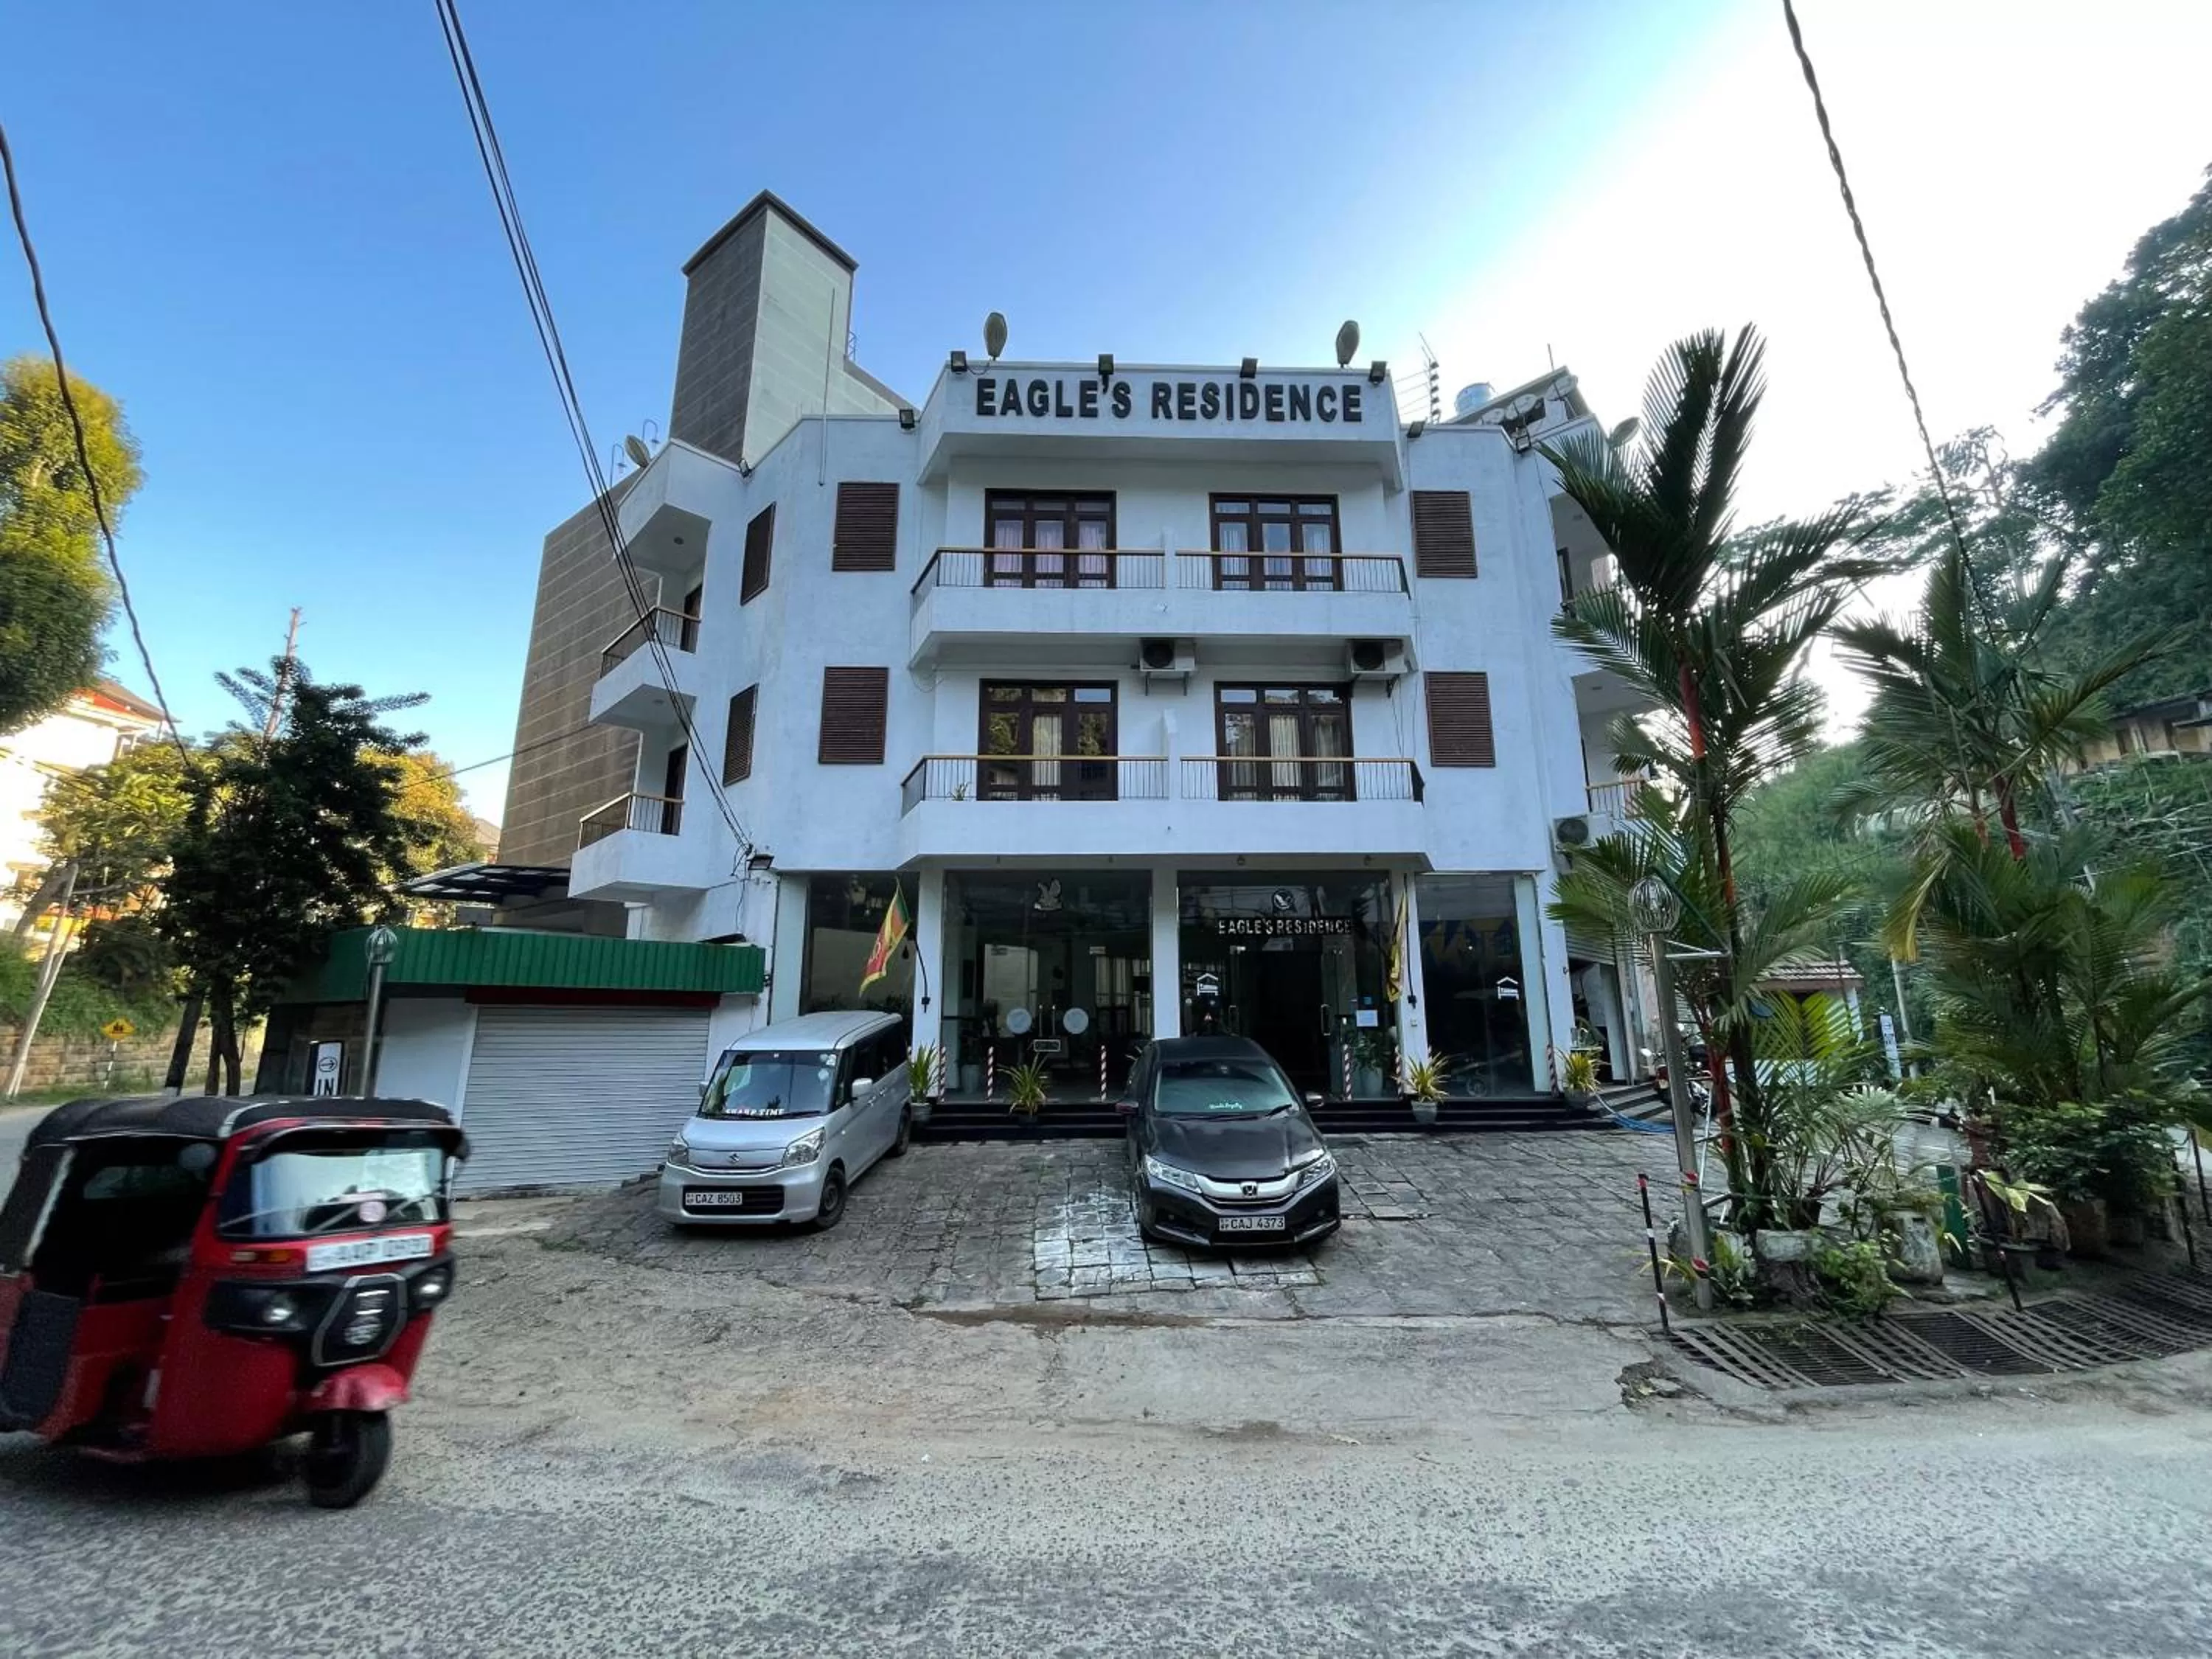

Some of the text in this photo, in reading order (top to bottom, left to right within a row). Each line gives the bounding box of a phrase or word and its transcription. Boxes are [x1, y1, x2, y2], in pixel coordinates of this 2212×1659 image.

[976, 378, 1362, 422] EAGLE'S RESIDENCE
[1218, 918, 1352, 935] EAGLE'S RESIDENCE
[316, 1077, 334, 1096] IN
[695, 1194, 714, 1204] CAZ
[1231, 1218, 1252, 1228] CAJ
[1257, 1218, 1284, 1228] 4373
